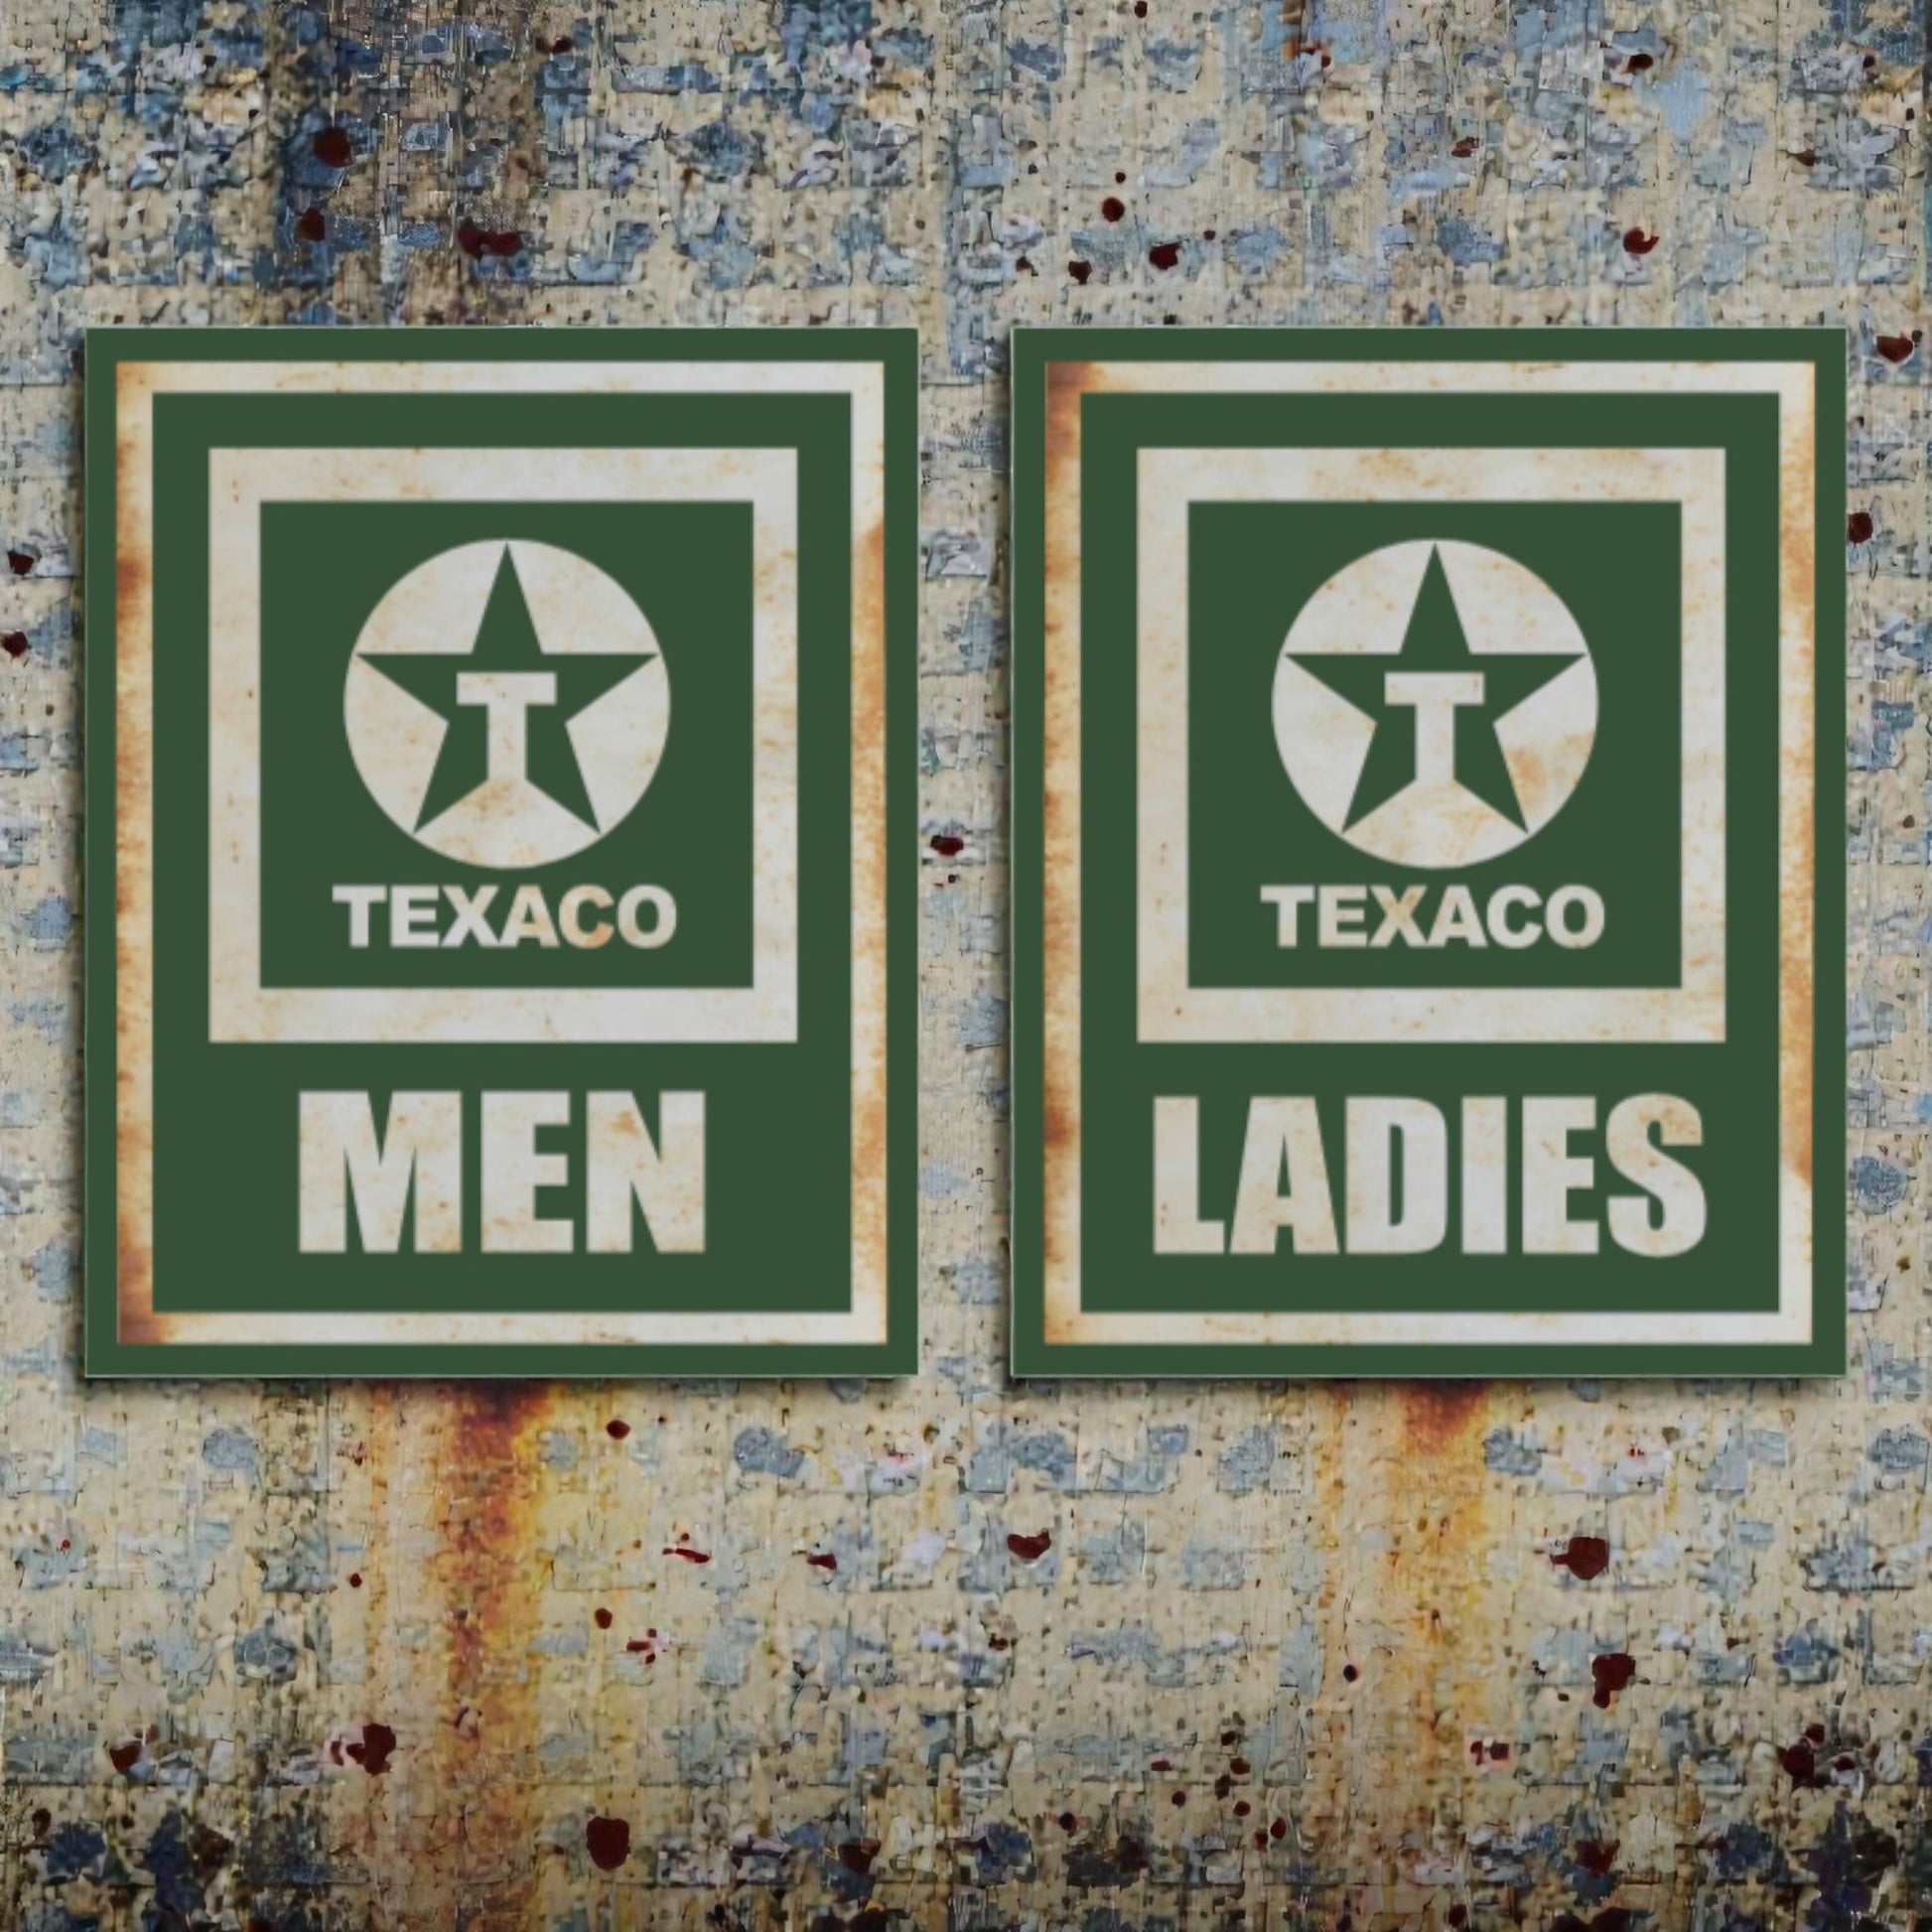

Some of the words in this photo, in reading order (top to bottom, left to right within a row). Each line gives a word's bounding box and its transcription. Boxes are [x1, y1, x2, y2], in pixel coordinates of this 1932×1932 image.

[332, 884, 677, 949] TEXACO
[1260, 884, 1605, 949] TEXACO
[299, 1090, 706, 1254] MEN
[1153, 1093, 1707, 1258] LADIES
